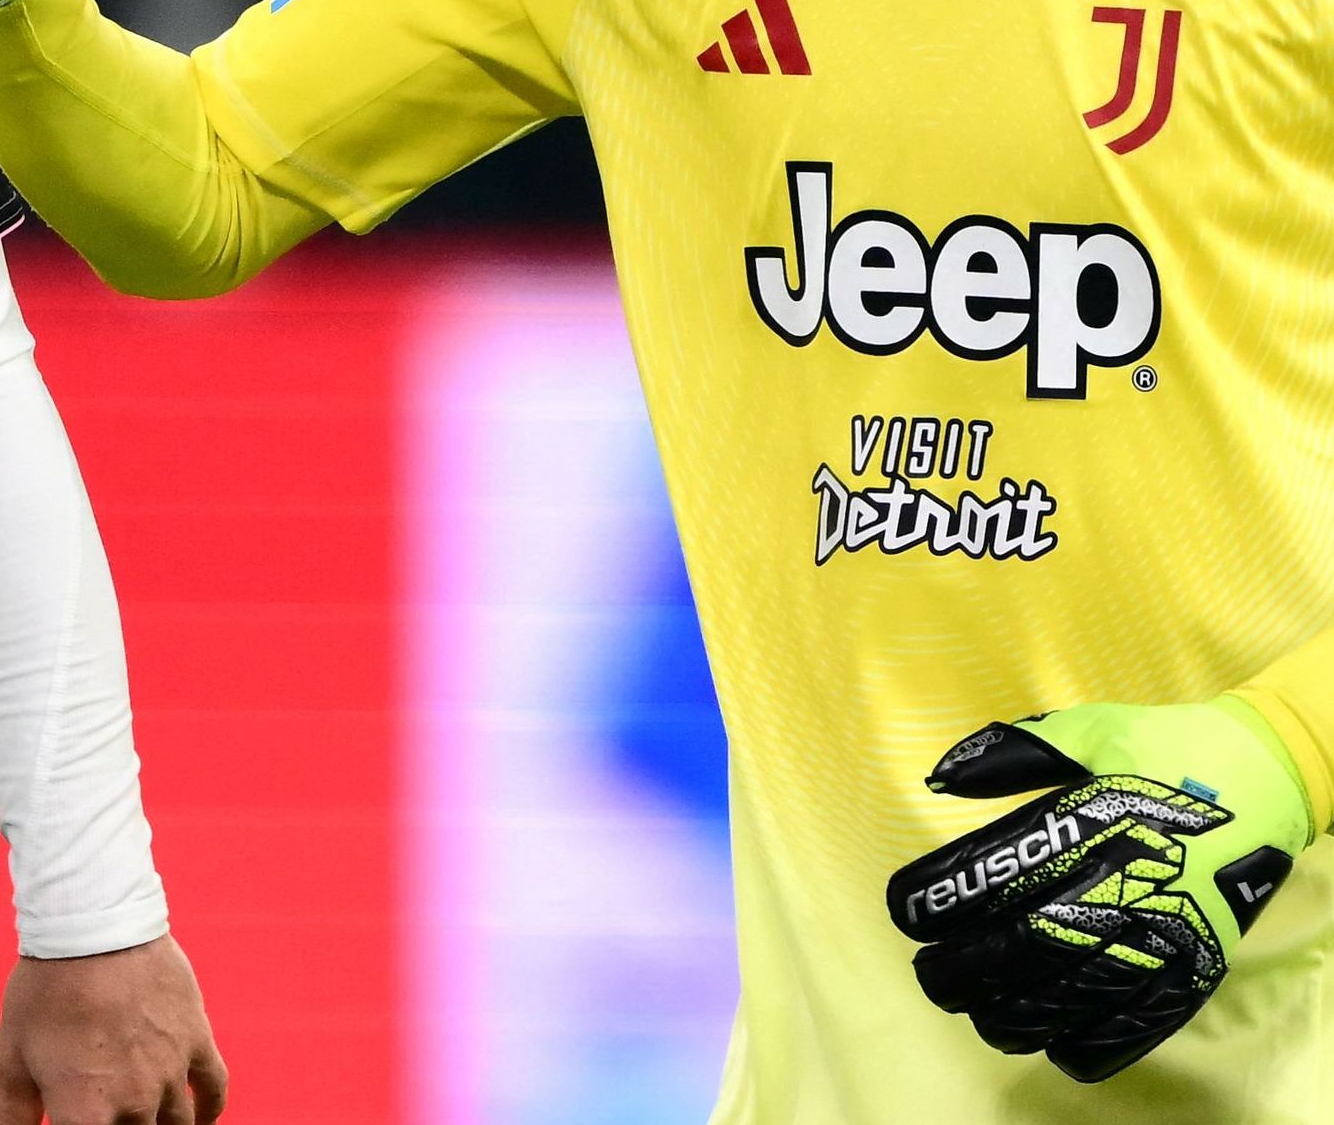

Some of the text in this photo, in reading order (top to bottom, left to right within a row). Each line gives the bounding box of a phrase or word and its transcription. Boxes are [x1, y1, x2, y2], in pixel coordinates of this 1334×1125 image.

[745, 161, 1161, 399] Jeep
[850, 413, 993, 479] VISIT
[812, 462, 1058, 566] Detroit
[904, 810, 1082, 926] reusch
